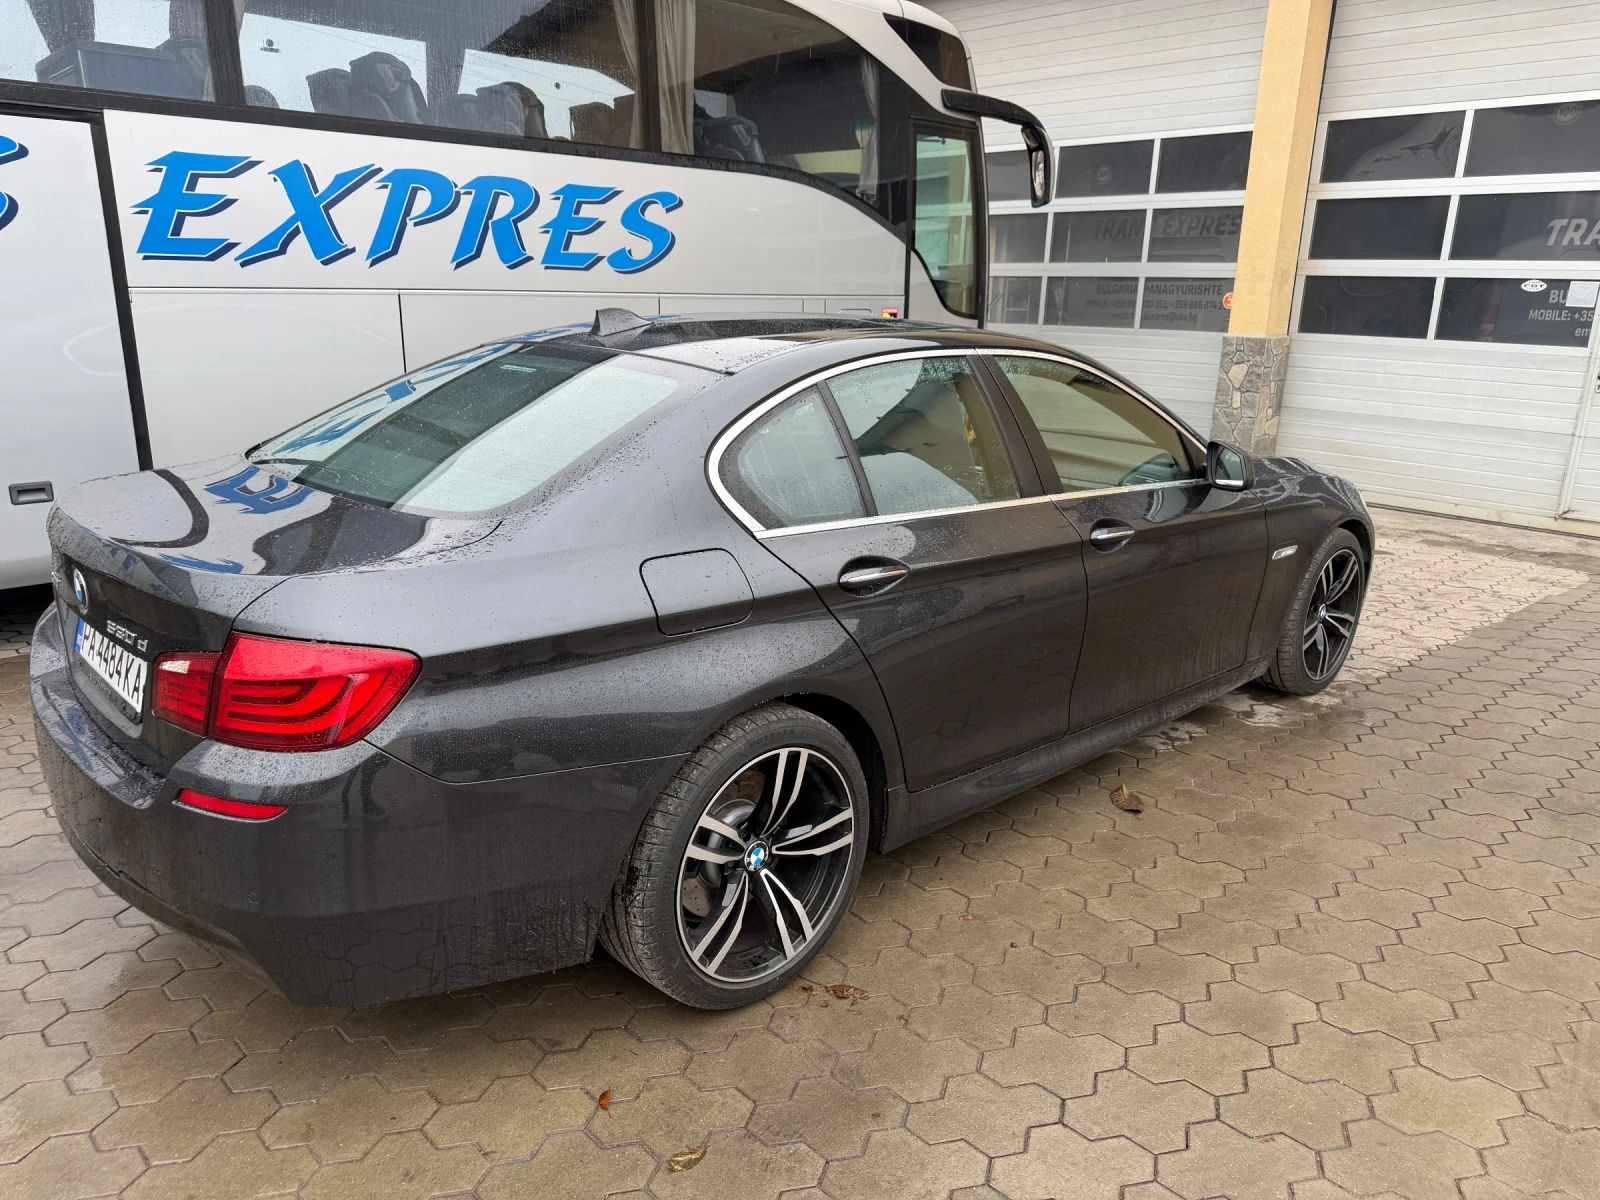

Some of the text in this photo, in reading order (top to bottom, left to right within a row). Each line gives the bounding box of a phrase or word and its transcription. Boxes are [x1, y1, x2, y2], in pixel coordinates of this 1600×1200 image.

[1559, 105, 1577, 117] 100
[130, 150, 683, 274] EXPRES
[1093, 213, 1242, 240] TRAN EXPRES
[1145, 283, 1223, 296] PANAGYURISHTE
[1528, 309, 1571, 322] MOBILE:
